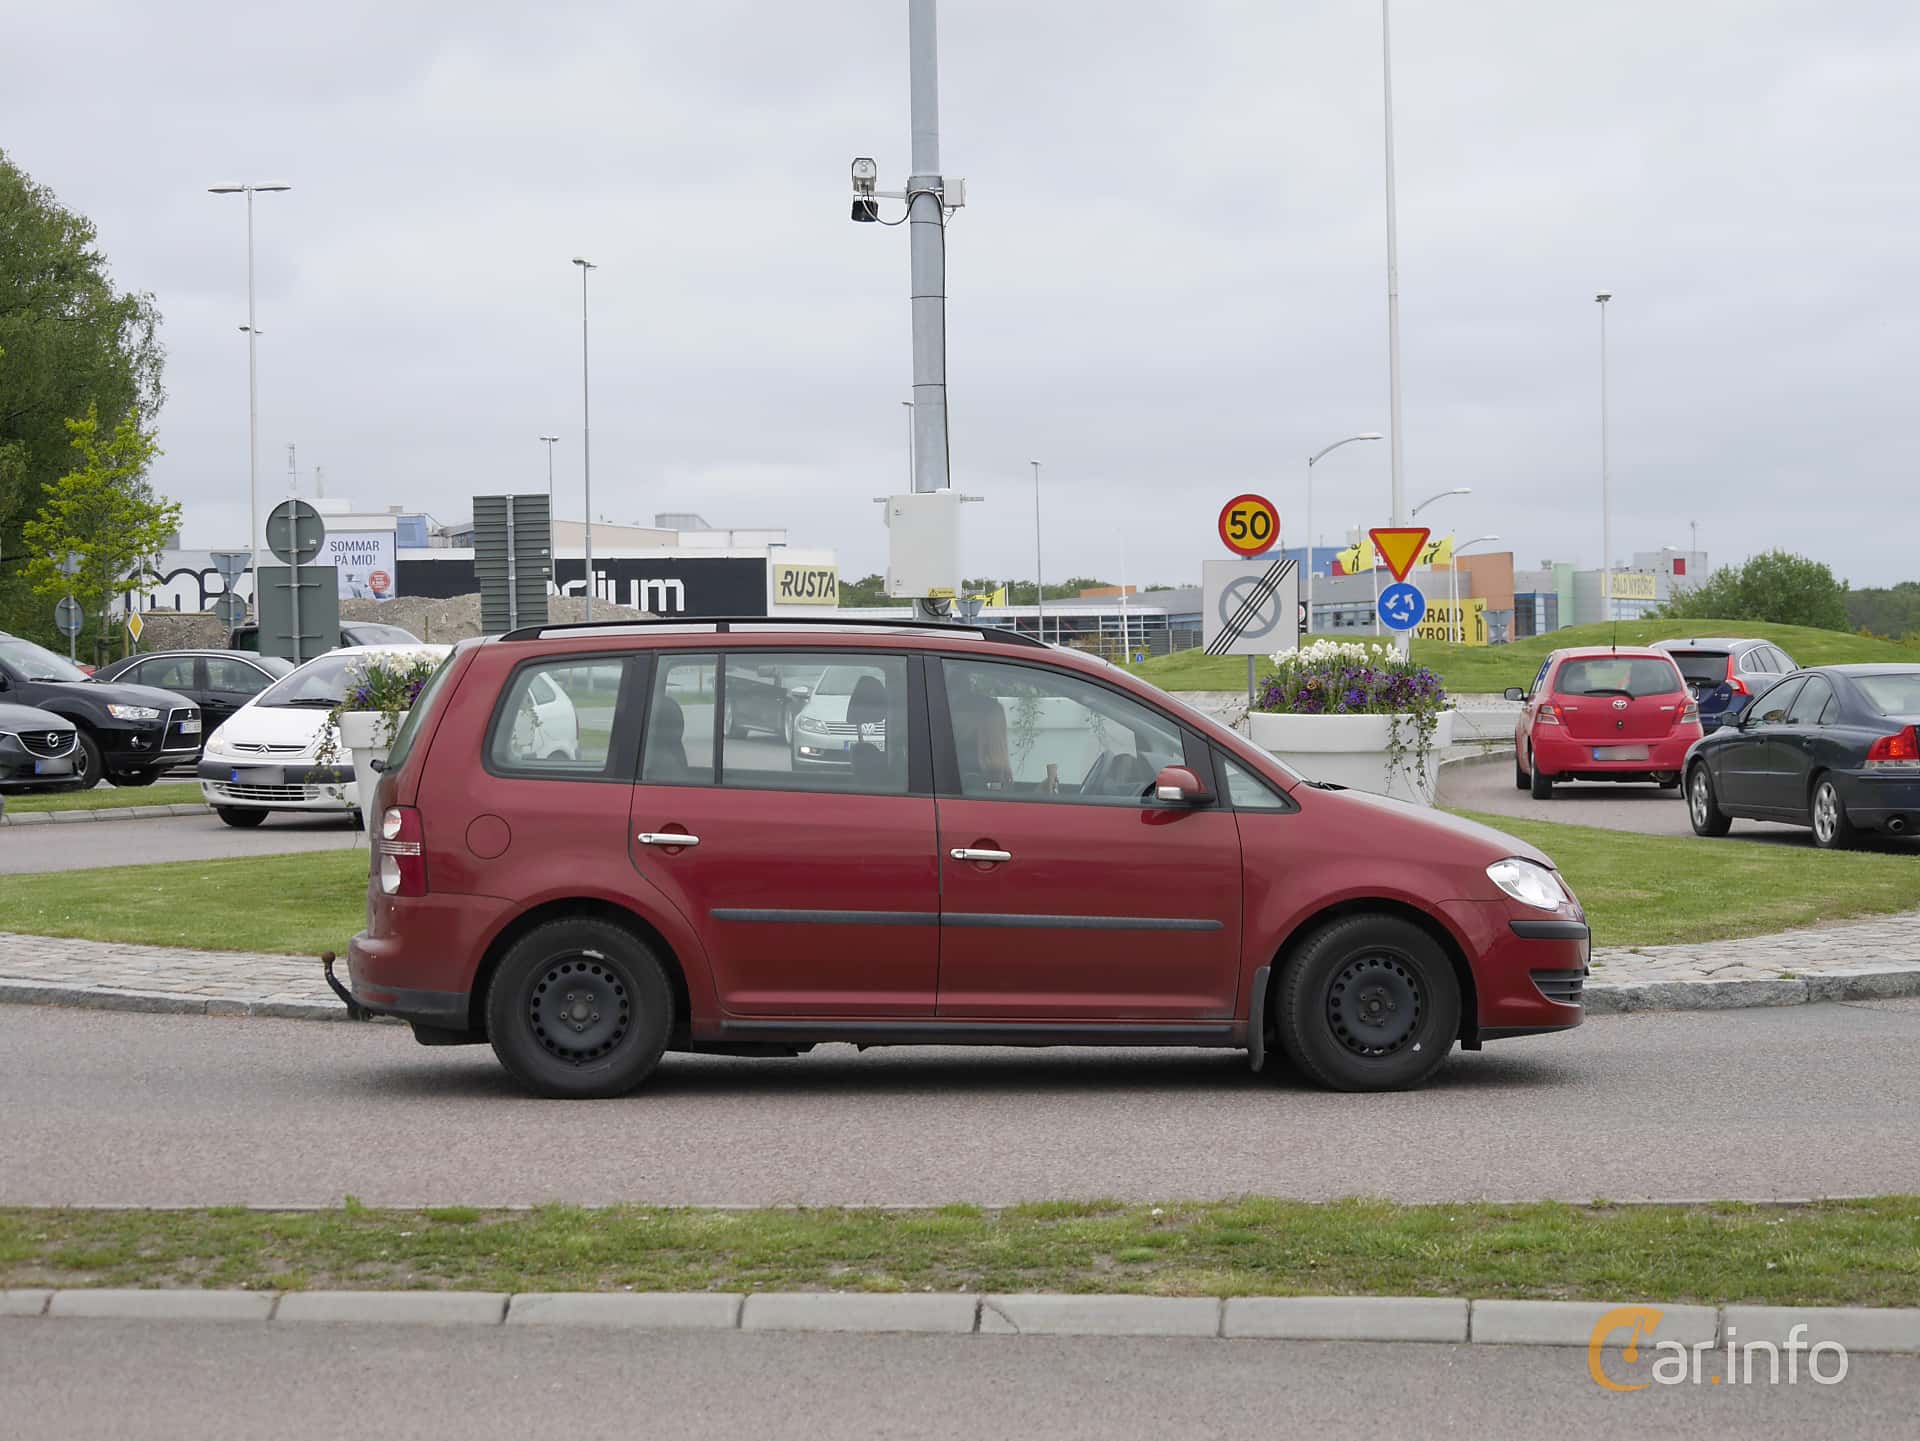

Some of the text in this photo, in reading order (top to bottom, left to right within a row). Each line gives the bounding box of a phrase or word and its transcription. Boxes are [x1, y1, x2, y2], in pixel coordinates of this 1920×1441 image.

[1230, 510, 1270, 540] 50
[330, 540, 380, 552] SOMMAR
[334, 553, 376, 566] PÅ MIO!
[780, 570, 836, 598] RUSTA
